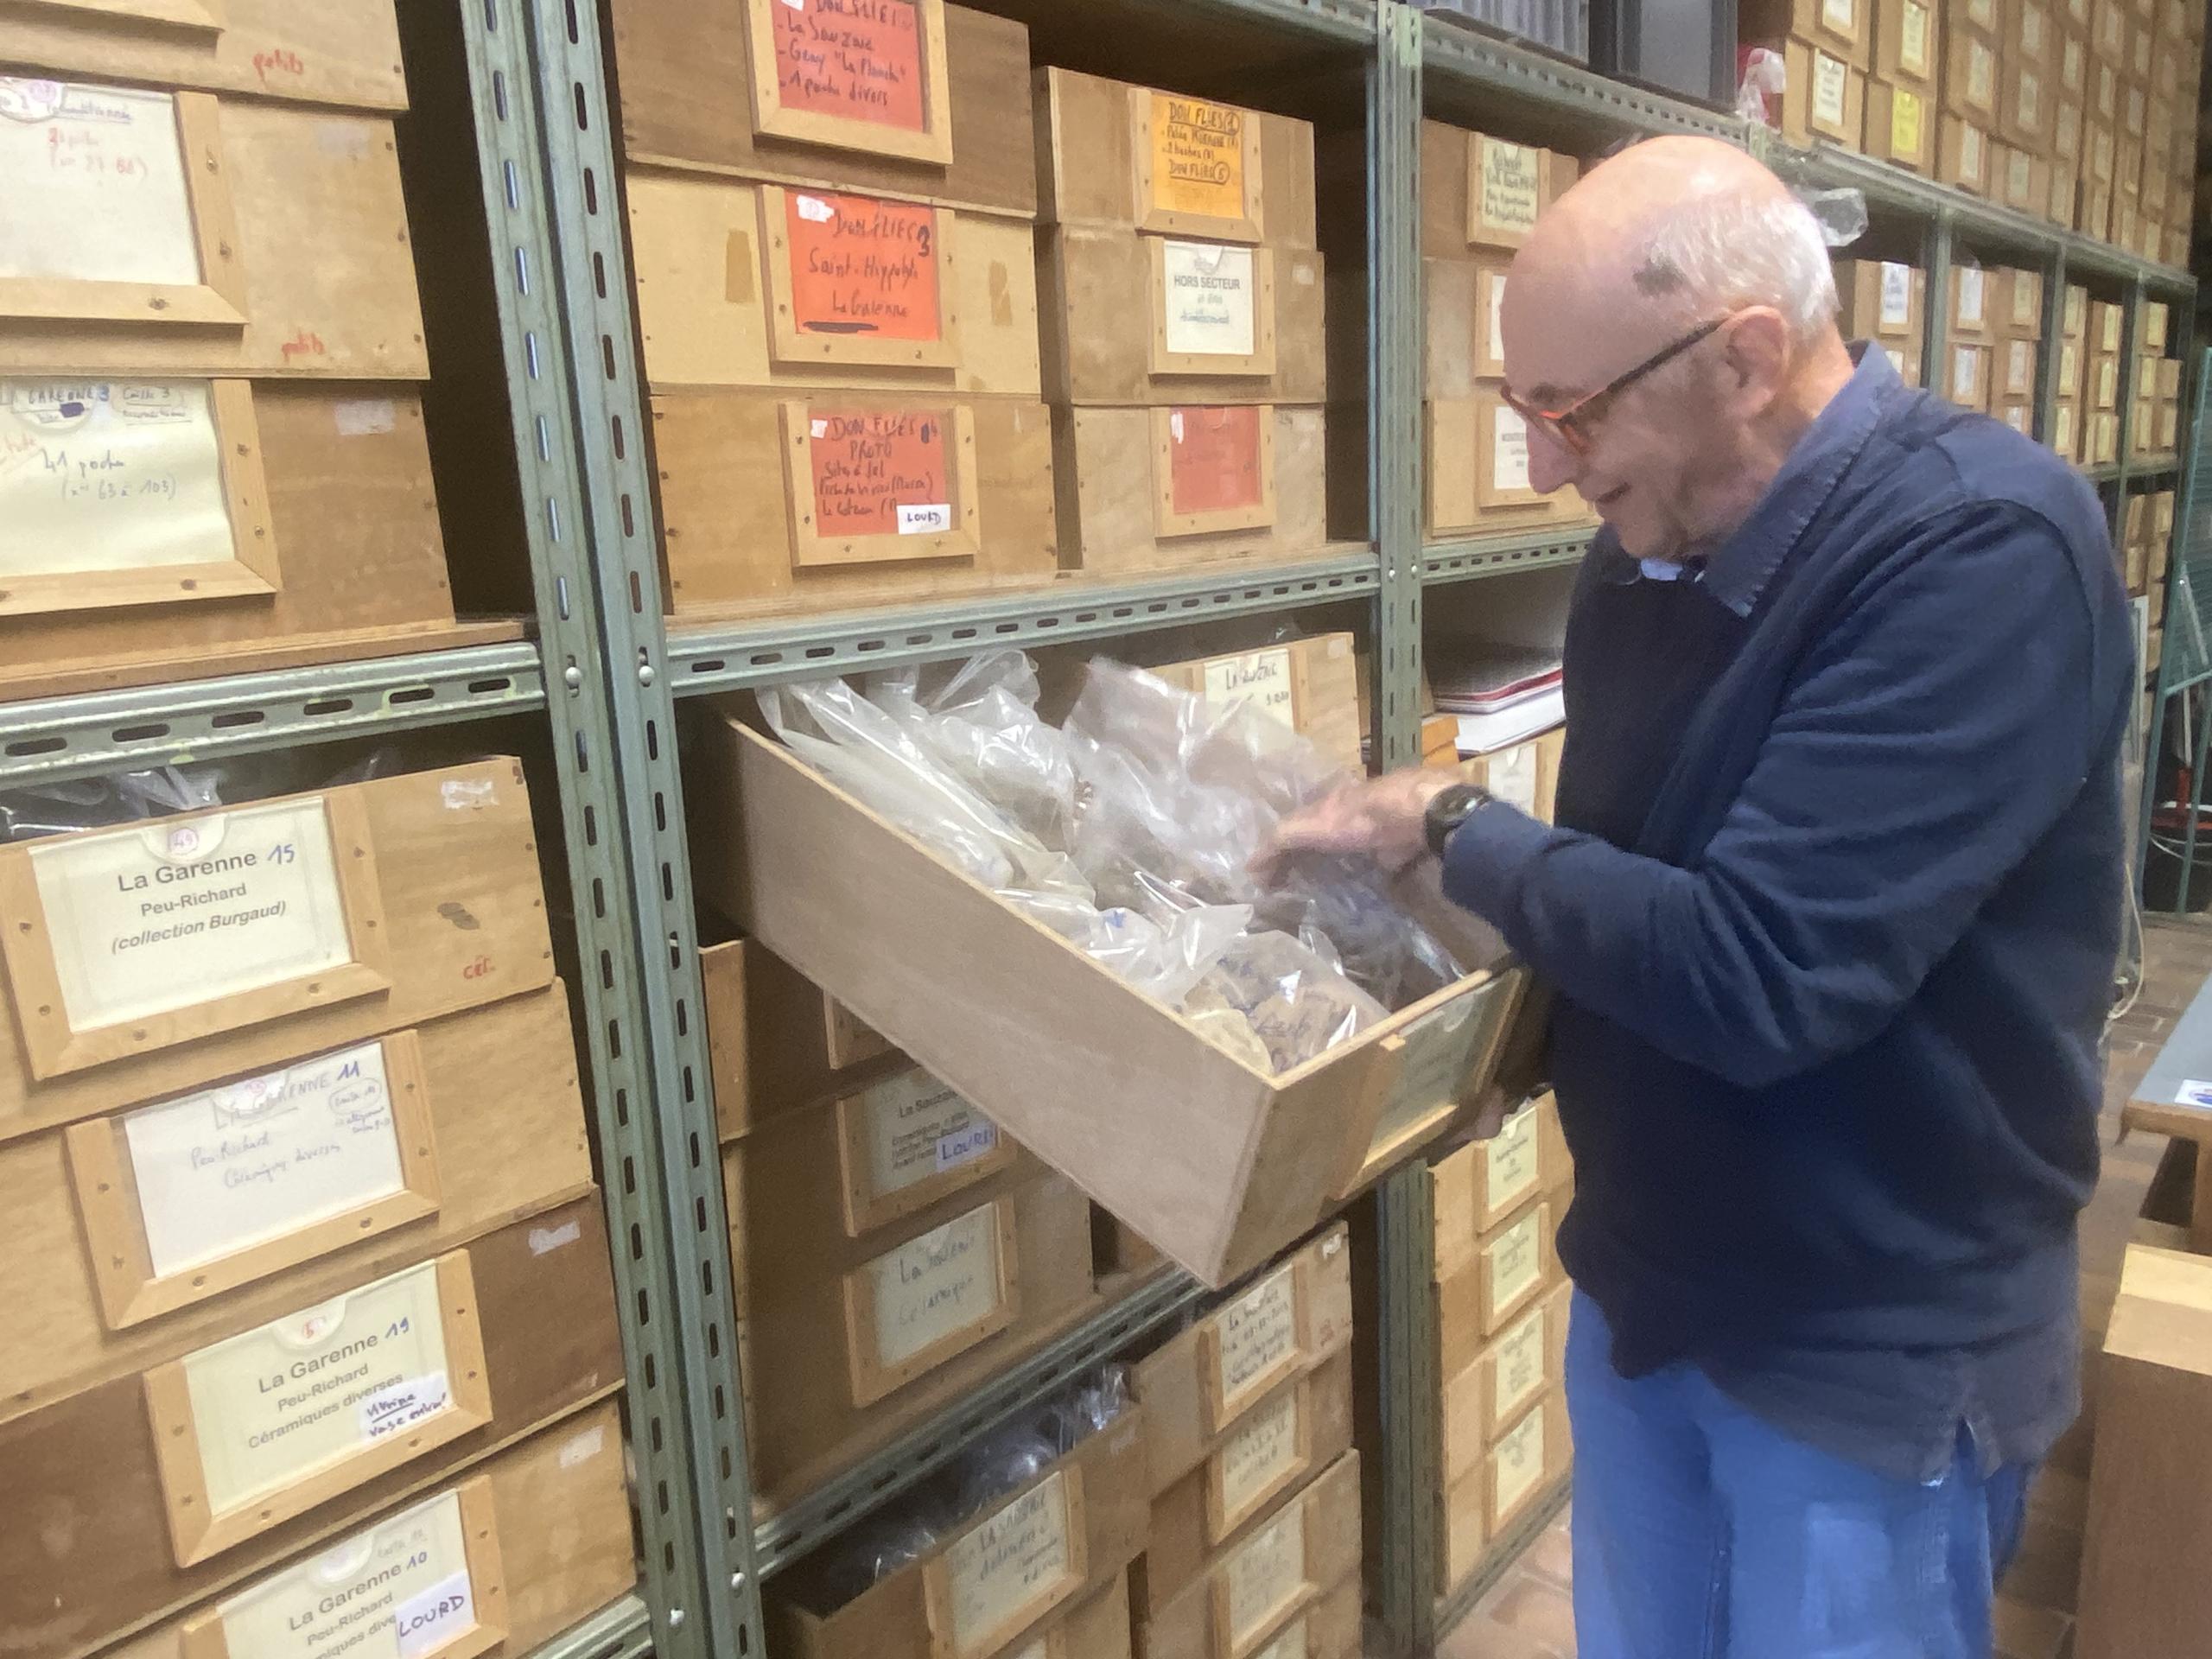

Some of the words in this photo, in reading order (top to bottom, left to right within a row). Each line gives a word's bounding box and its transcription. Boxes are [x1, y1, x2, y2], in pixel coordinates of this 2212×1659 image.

[1174, 276, 1198, 288] HORS
[1200, 276, 1241, 290] SECTEUR
[118, 874, 149, 892] La
[155, 852, 257, 884] Garenne
[267, 843, 296, 865] 15
[140, 883, 247, 917] Peu-Richard
[111, 921, 205, 955] (collection
[209, 899, 287, 929] Burgaud)
[258, 1374, 284, 1394] La
[290, 1334, 378, 1379] Garenne
[277, 1363, 369, 1412] Peu-Richard
[248, 1402, 340, 1450] Céramiques
[342, 1374, 404, 1407] diverses
[406, 1551, 428, 1570] 10
[289, 1611, 314, 1631] La
[318, 1563, 402, 1613] Garenne
[398, 1595, 465, 1637] LOURD
[307, 1592, 394, 1646] Peu-Richard
[368, 1613, 397, 1636] dive
